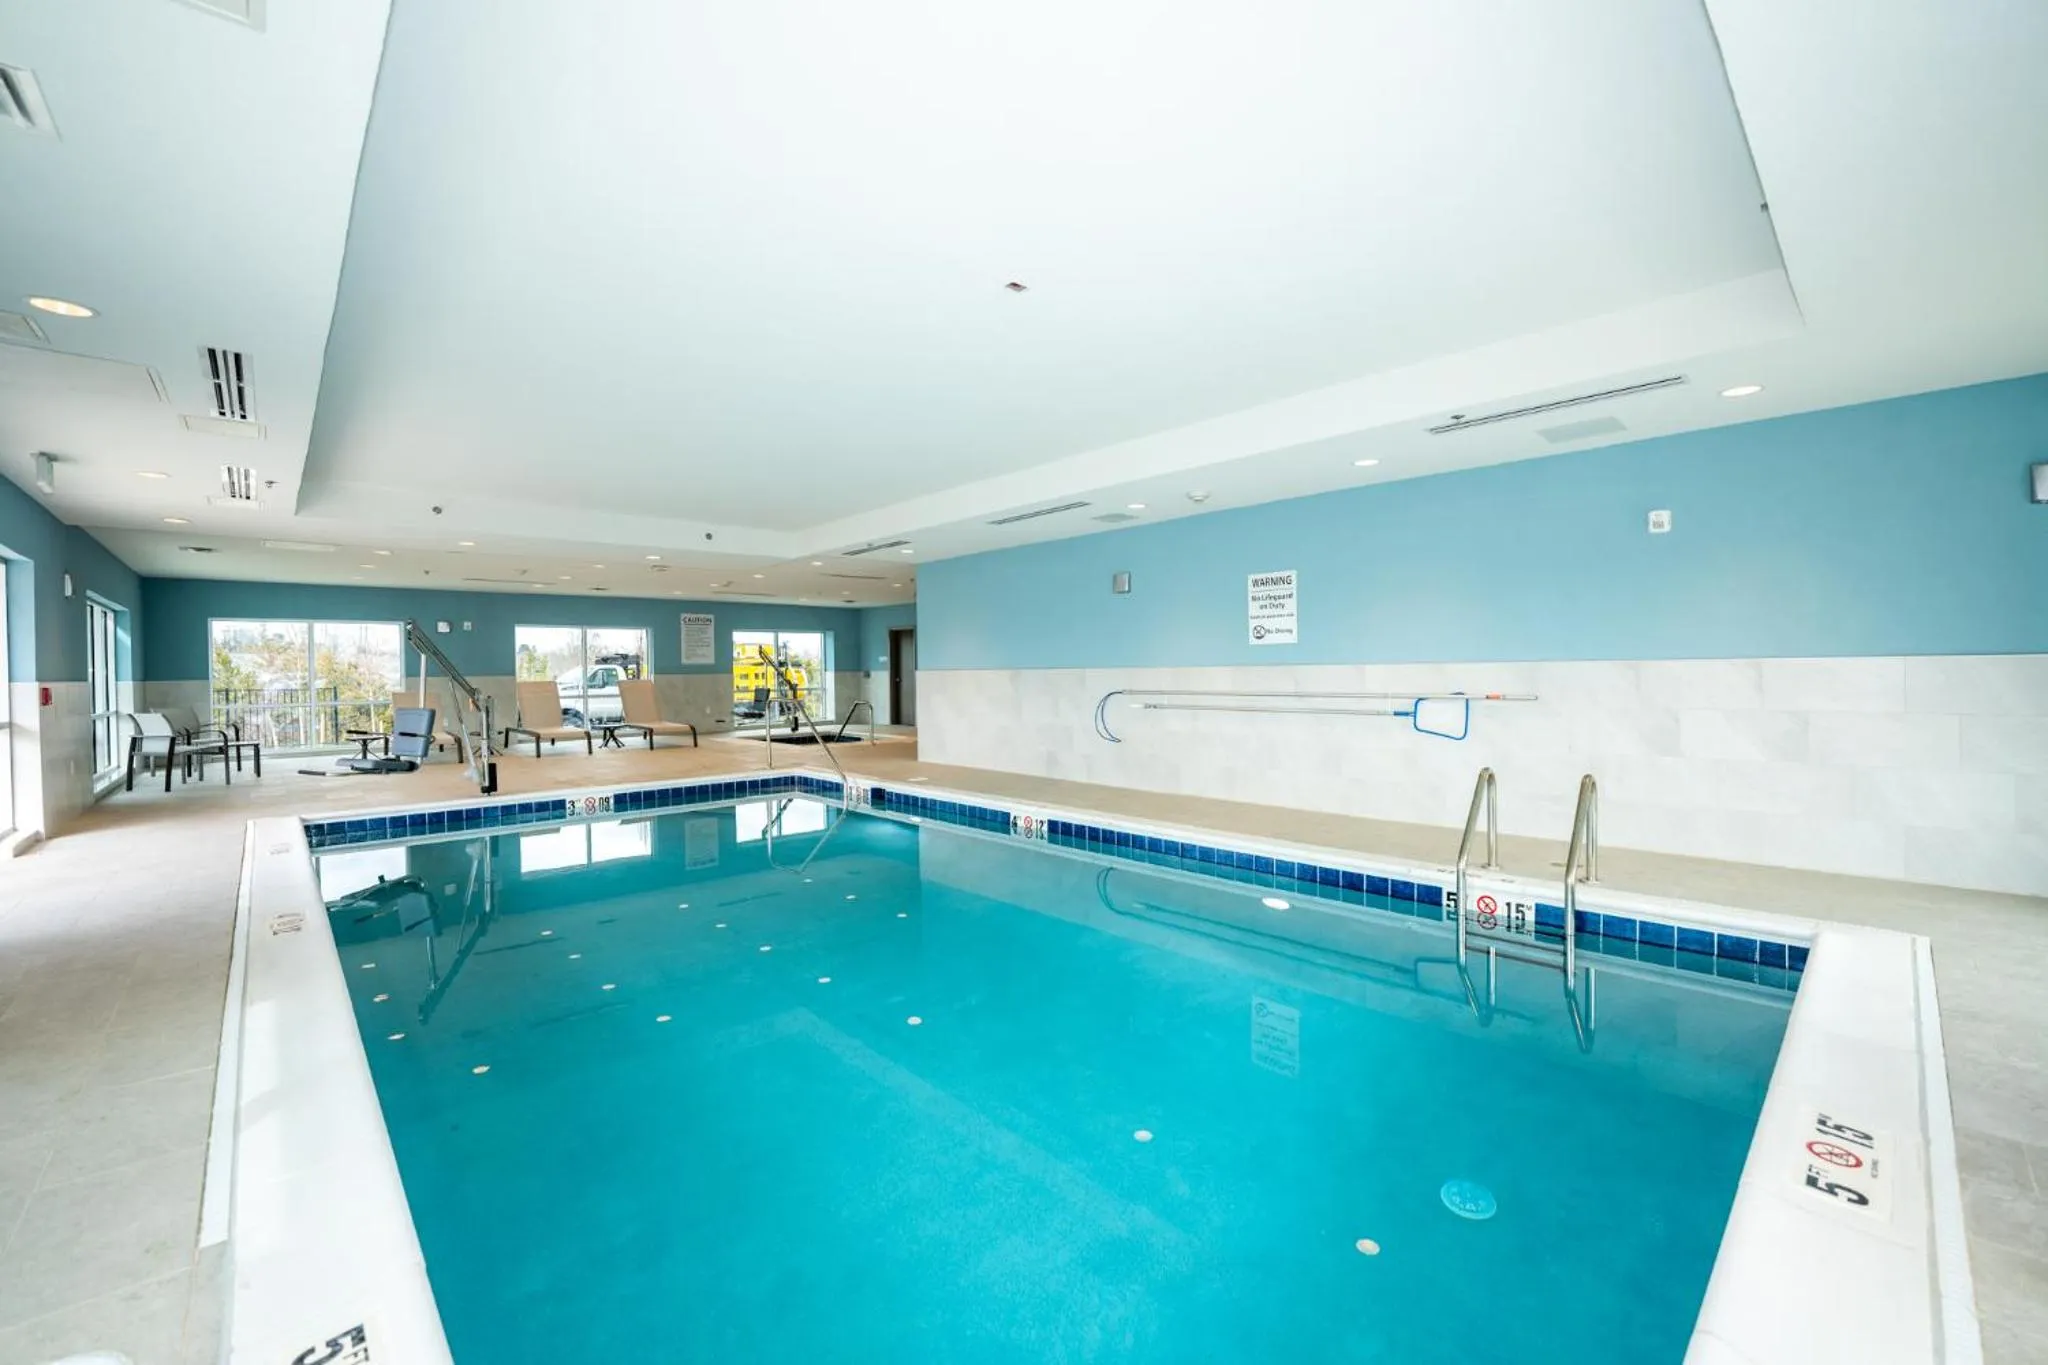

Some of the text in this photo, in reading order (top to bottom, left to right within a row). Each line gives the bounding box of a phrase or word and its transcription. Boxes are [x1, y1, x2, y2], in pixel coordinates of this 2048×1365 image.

[1251, 575, 1293, 588] WARNING
[1261, 592, 1293, 602] Lifeguard
[682, 616, 713, 625] CAUTION
[1445, 891, 1458, 904] 5
[1805, 1173, 1869, 1206] 5
